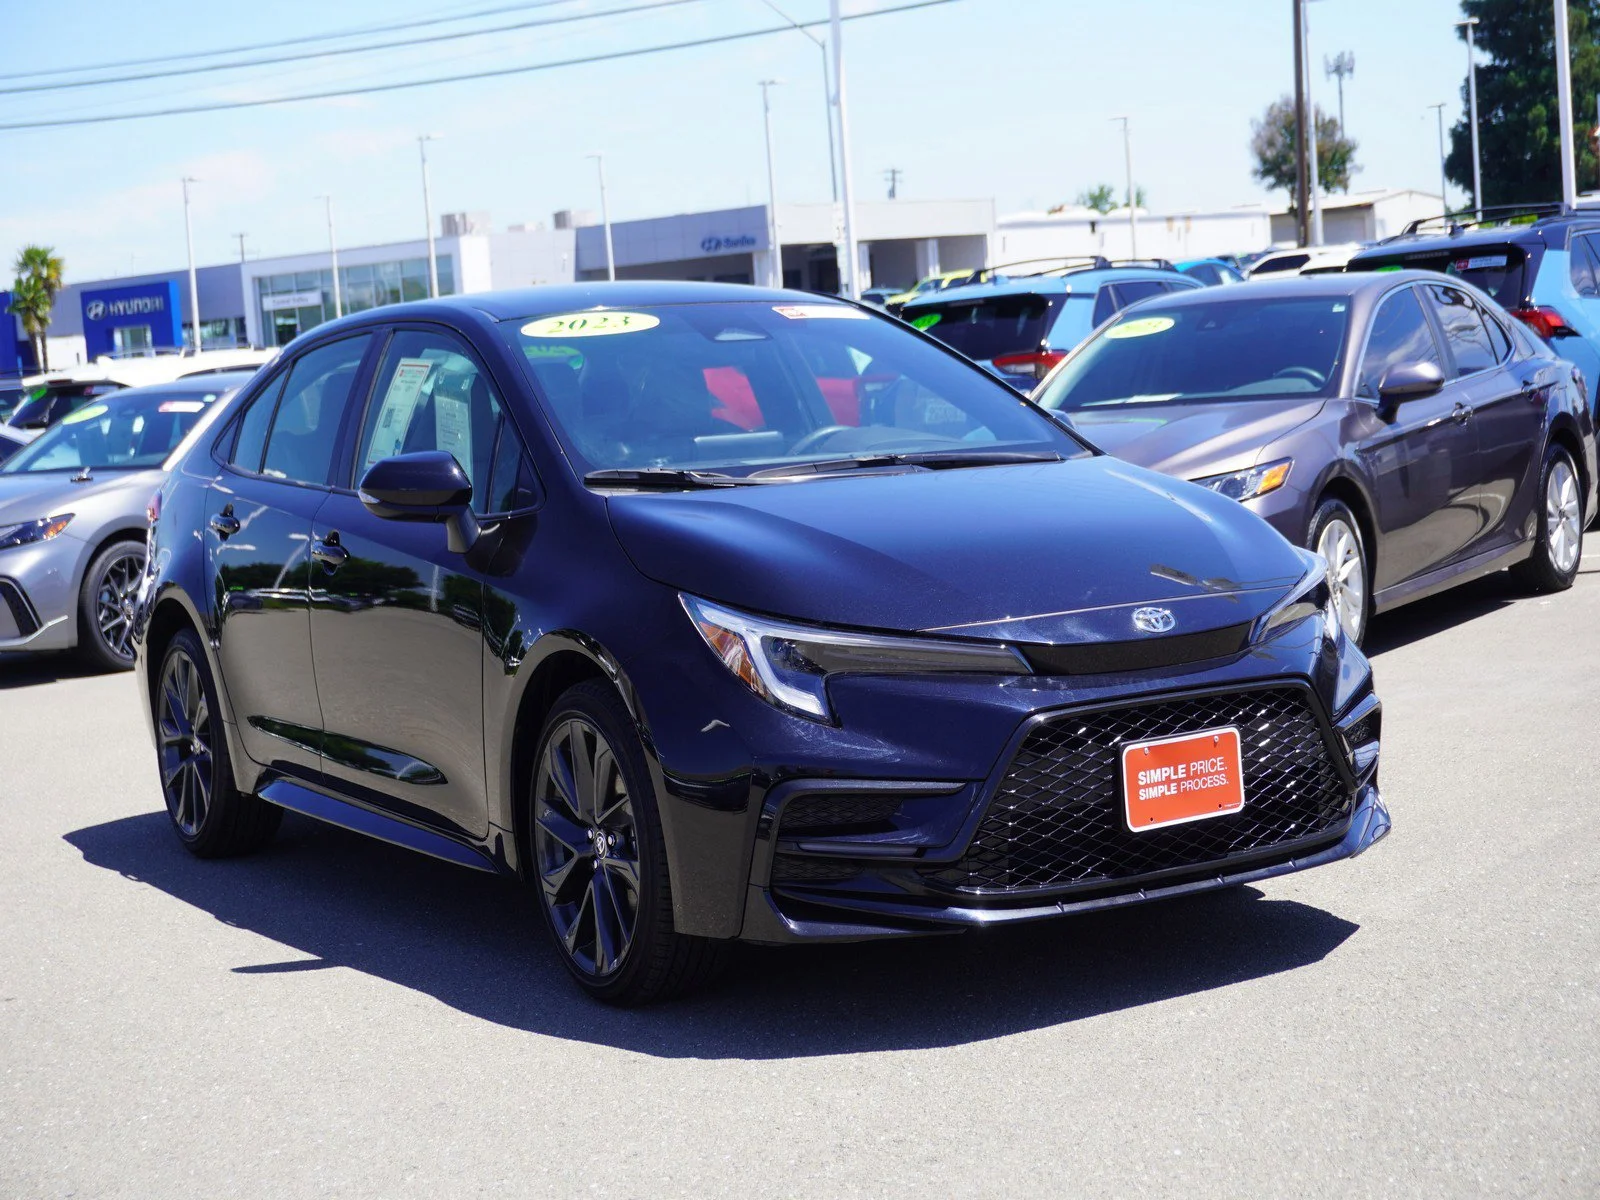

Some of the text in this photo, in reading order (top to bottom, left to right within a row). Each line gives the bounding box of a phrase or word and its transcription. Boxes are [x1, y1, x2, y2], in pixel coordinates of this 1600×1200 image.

[109, 296, 164, 316] HYUNDAI
[547, 316, 630, 334] 2023
[1138, 757, 1228, 785] SIMPLE PRICE.
[1139, 774, 1229, 801] SIMPLE PROCESS.
